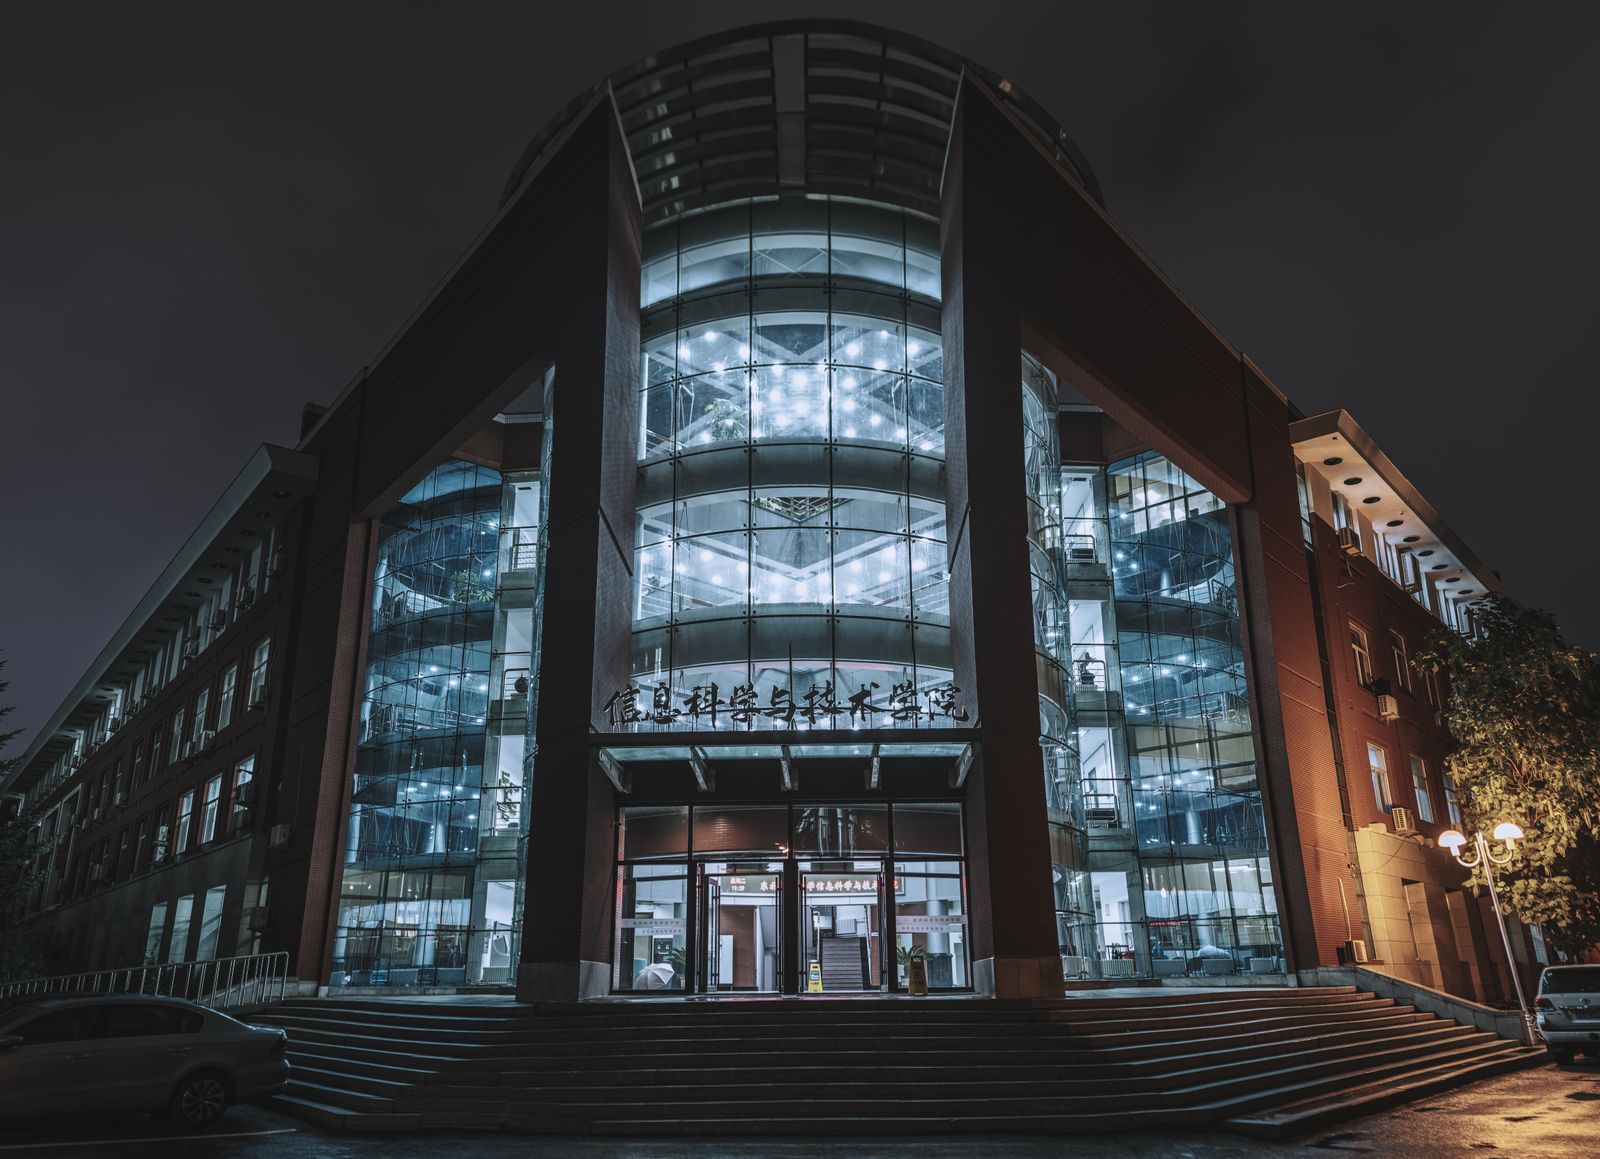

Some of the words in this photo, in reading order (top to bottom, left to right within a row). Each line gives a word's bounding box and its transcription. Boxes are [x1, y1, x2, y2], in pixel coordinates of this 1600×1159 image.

[603, 679, 970, 728] 信息科学与技术学院
